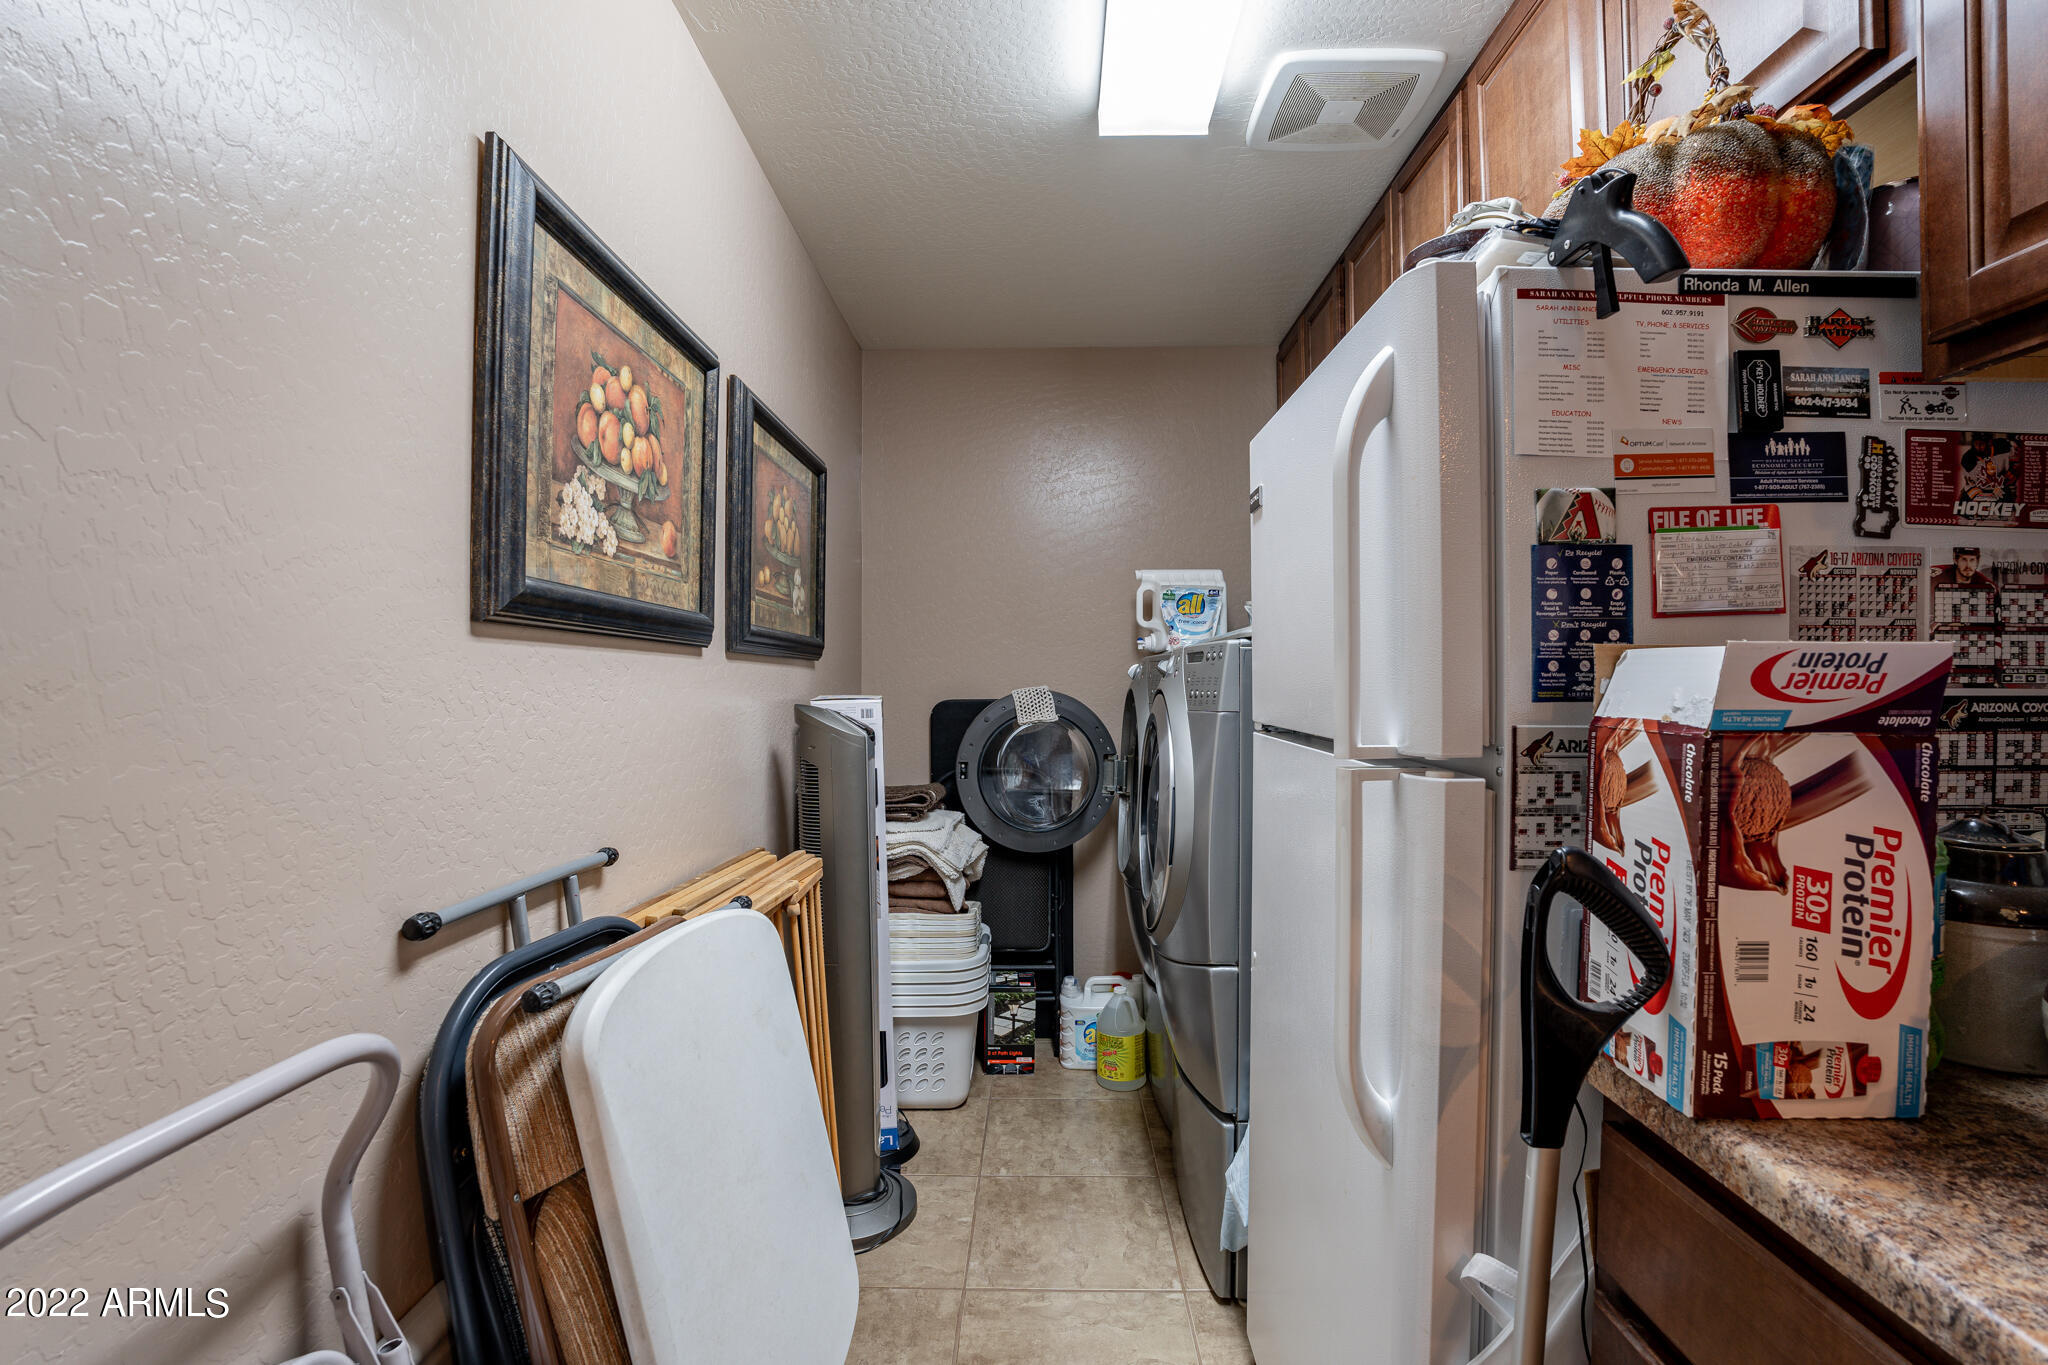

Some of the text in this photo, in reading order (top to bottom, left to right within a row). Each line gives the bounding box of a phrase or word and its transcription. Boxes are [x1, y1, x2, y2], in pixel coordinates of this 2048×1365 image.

[1684, 278, 1809, 293] Rhonda M. Allen
[1637, 366, 1675, 374] EMERGENCY
[1791, 373, 1861, 383] SARAH ANN RANCH
[1794, 396, 1858, 408] 602-647-3034
[1869, 455, 1877, 508] COOKOUT
[1953, 501, 2026, 517] HOCKEY
[1653, 510, 1690, 530] FILE
[1696, 510, 1720, 528] OF
[1830, 552, 1922, 567] 16-17 ARIZONA COYOTES
[1991, 561, 2028, 575] ARIZONA
[1178, 593, 1204, 614] all
[1797, 652, 1888, 673] Protein
[1780, 672, 1888, 695] Premier
[1970, 702, 2048, 713] ARIZONA COYO
[1878, 715, 1931, 727] Chocolate
[1555, 739, 1589, 753] ARIZ
[1684, 744, 1696, 803] Chocolate
[1920, 742, 1930, 802] Chocolate
[1707, 849, 1718, 898] HIGH PROTEIN SHAKE
[1649, 837, 1671, 944] Prem
[1794, 874, 1805, 920] PROTEIN
[1805, 876, 1830, 925] 30g
[1840, 833, 1875, 958] Protein
[1868, 826, 1903, 976] Premier
[1805, 936, 1818, 961] 160
[1609, 979, 1617, 995] 24
[1805, 976, 1817, 989] 1g
[1803, 1005, 1816, 1023] 24
[1778, 1047, 1788, 1065] 30g
[1825, 1048, 1835, 1084] Protein
[1712, 1051, 1728, 1095] 15 Pack
[1833, 1046, 1844, 1088] Premier
[1903, 1034, 1914, 1106] IMMUNE HEALTH
